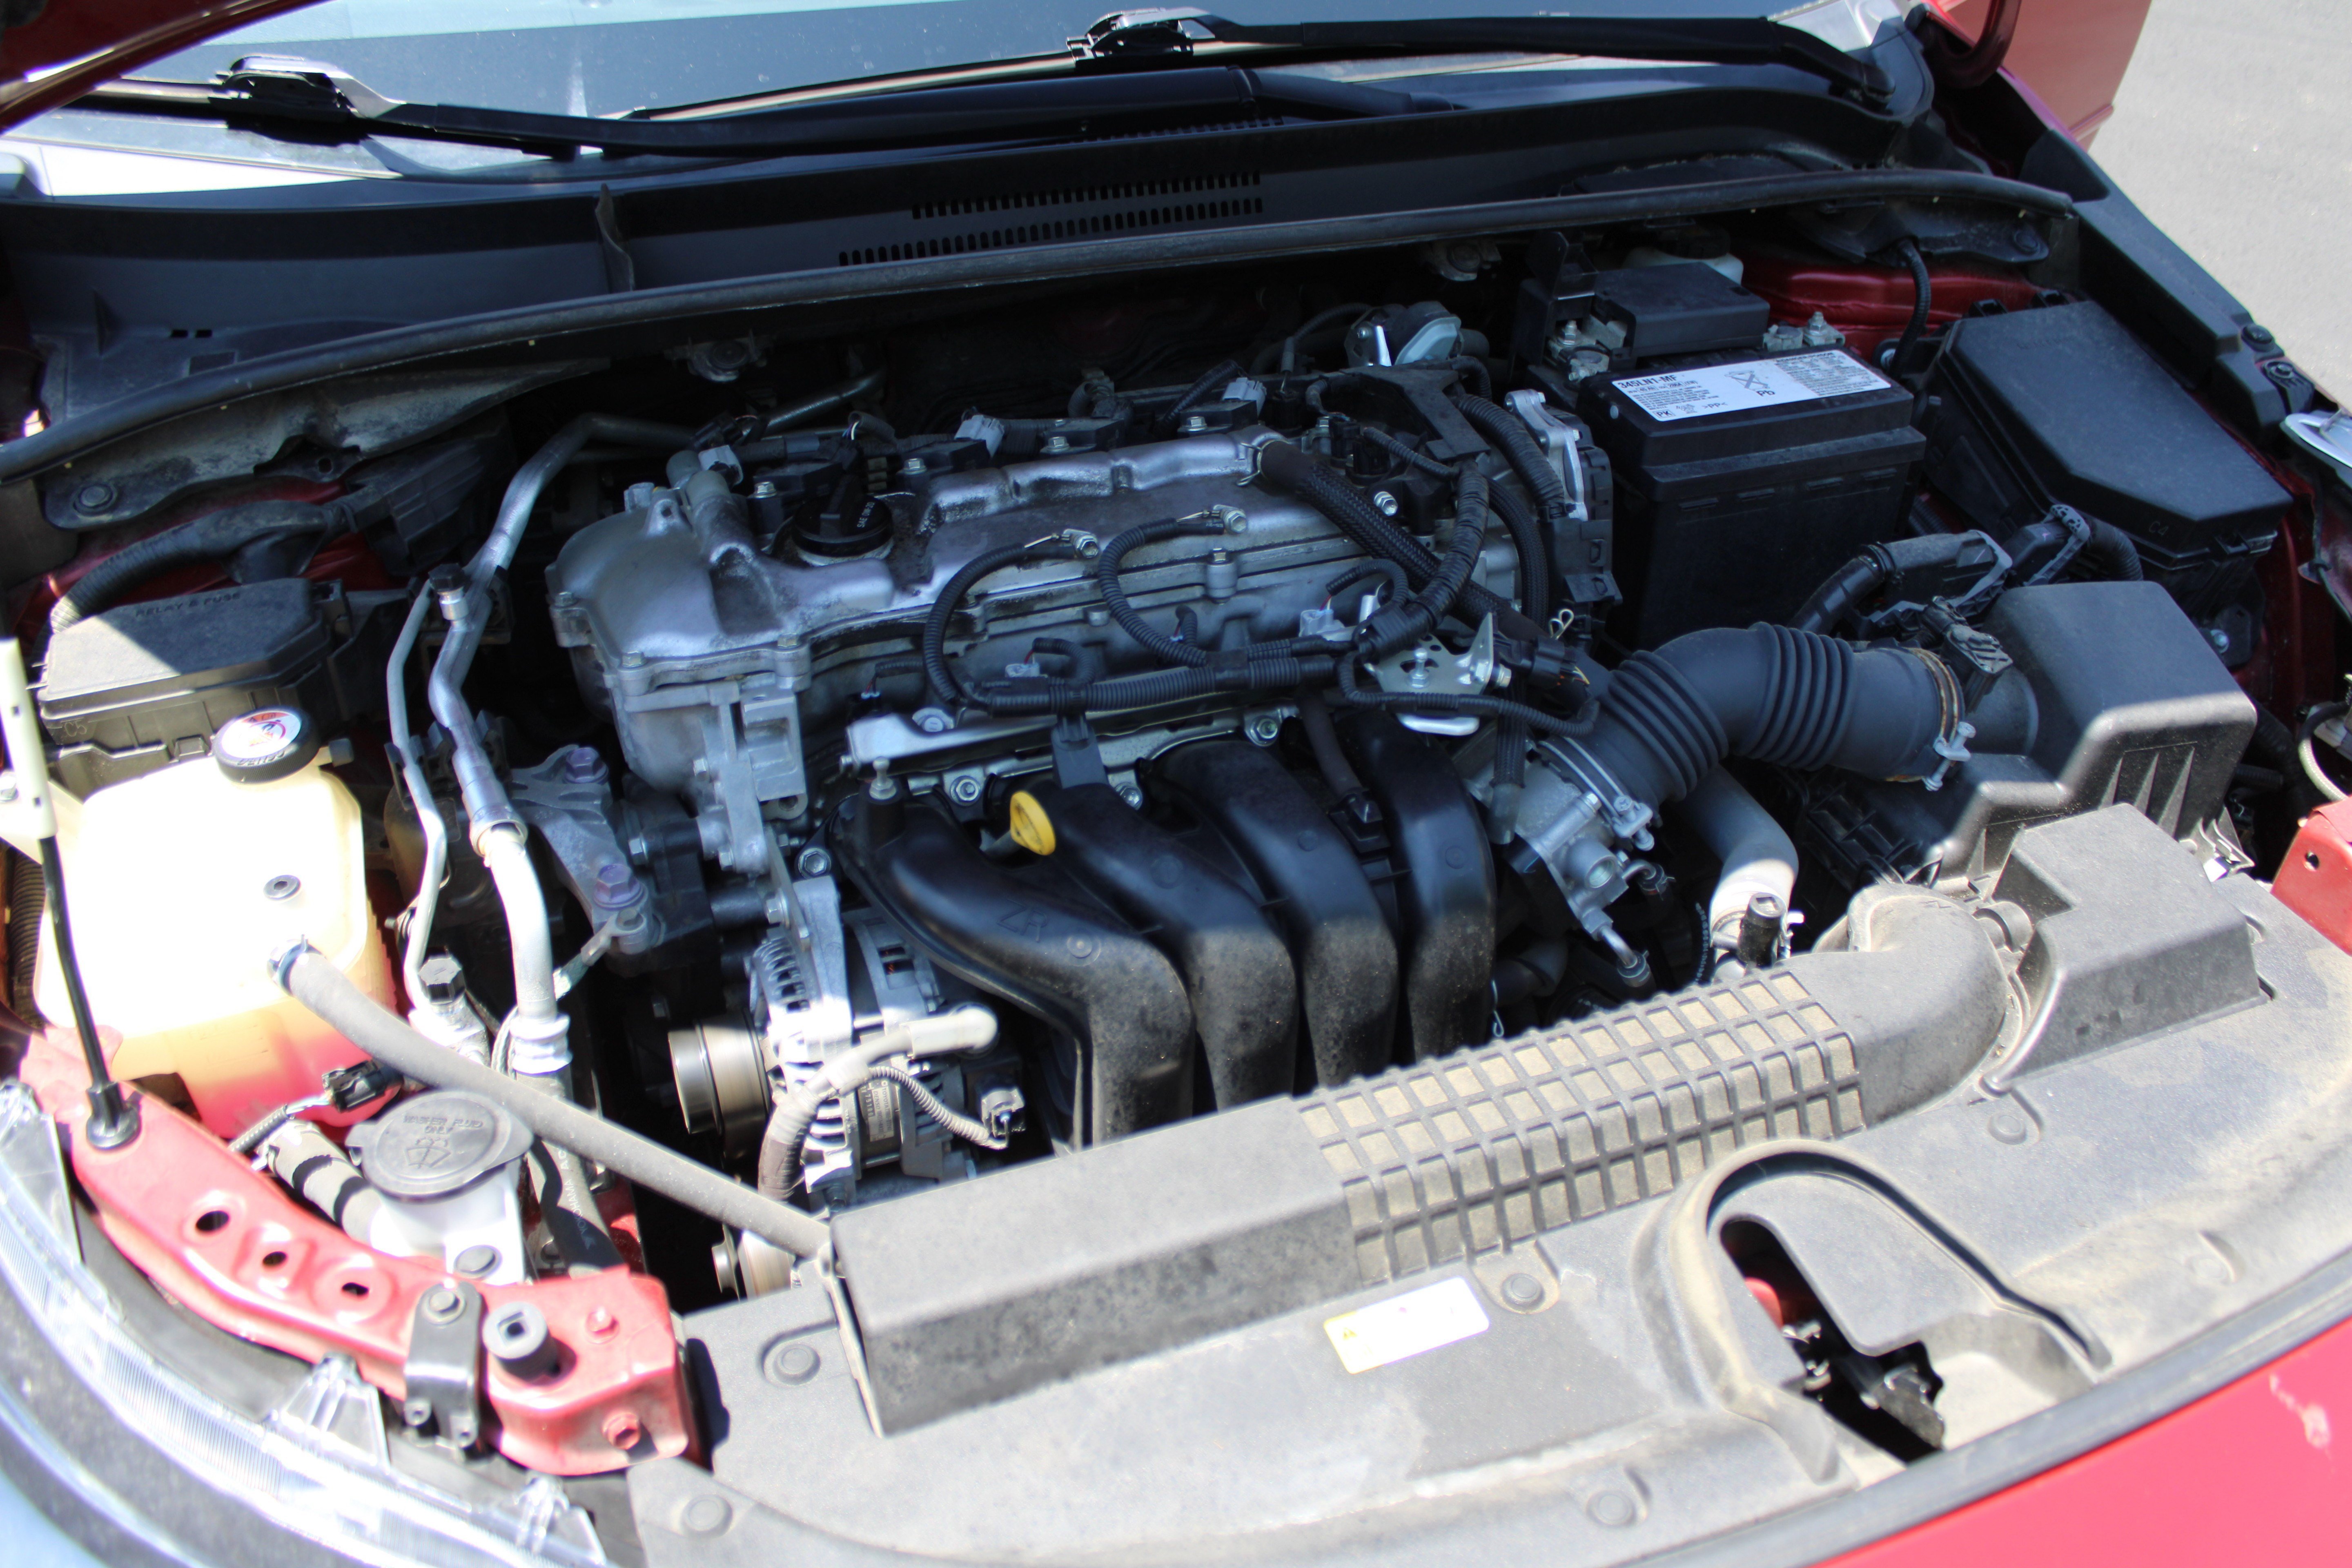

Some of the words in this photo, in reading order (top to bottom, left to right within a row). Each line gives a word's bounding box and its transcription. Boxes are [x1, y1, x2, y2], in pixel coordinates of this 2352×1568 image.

[1618, 374, 1677, 389] 345LN1-MF
[1756, 389, 1776, 398] Pb
[1657, 410, 1673, 418] PK
[856, 517, 869, 528] SAE
[2149, 520, 2169, 536] C4
[136, 602, 184, 617] RELAY
[203, 592, 241, 606] FUSE
[64, 720, 87, 737] C5
[996, 898, 1049, 944] ZR
[865, 1094, 874, 1117] 75100
[403, 1115, 447, 1125] WASHER
[452, 1118, 483, 1129] FLUID
[424, 1125, 454, 1134] ONLY
[564, 1178, 588, 1235] YOKOHAMA
